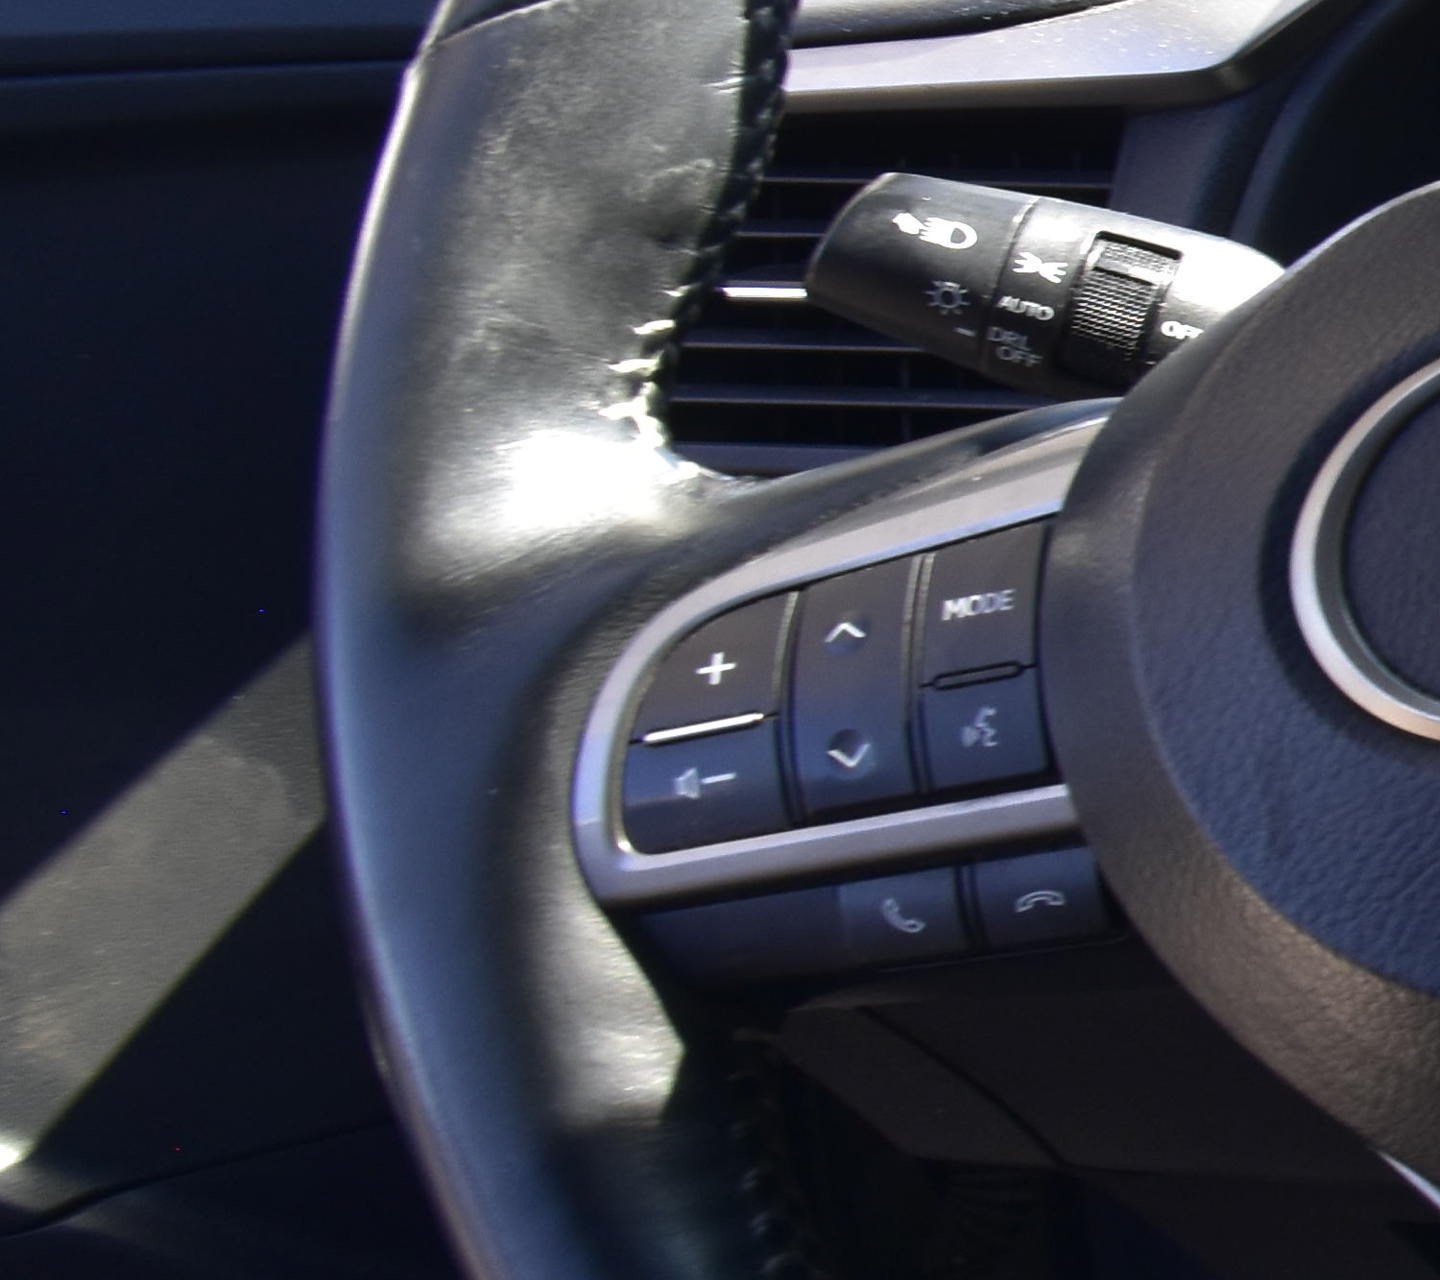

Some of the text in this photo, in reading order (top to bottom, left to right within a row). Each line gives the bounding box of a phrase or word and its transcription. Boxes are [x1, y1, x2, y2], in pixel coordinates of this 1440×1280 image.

[995, 294, 1056, 322] AUTO
[987, 325, 1031, 352] DRL
[996, 345, 1044, 368] OFF
[941, 588, 1015, 621] MODE
